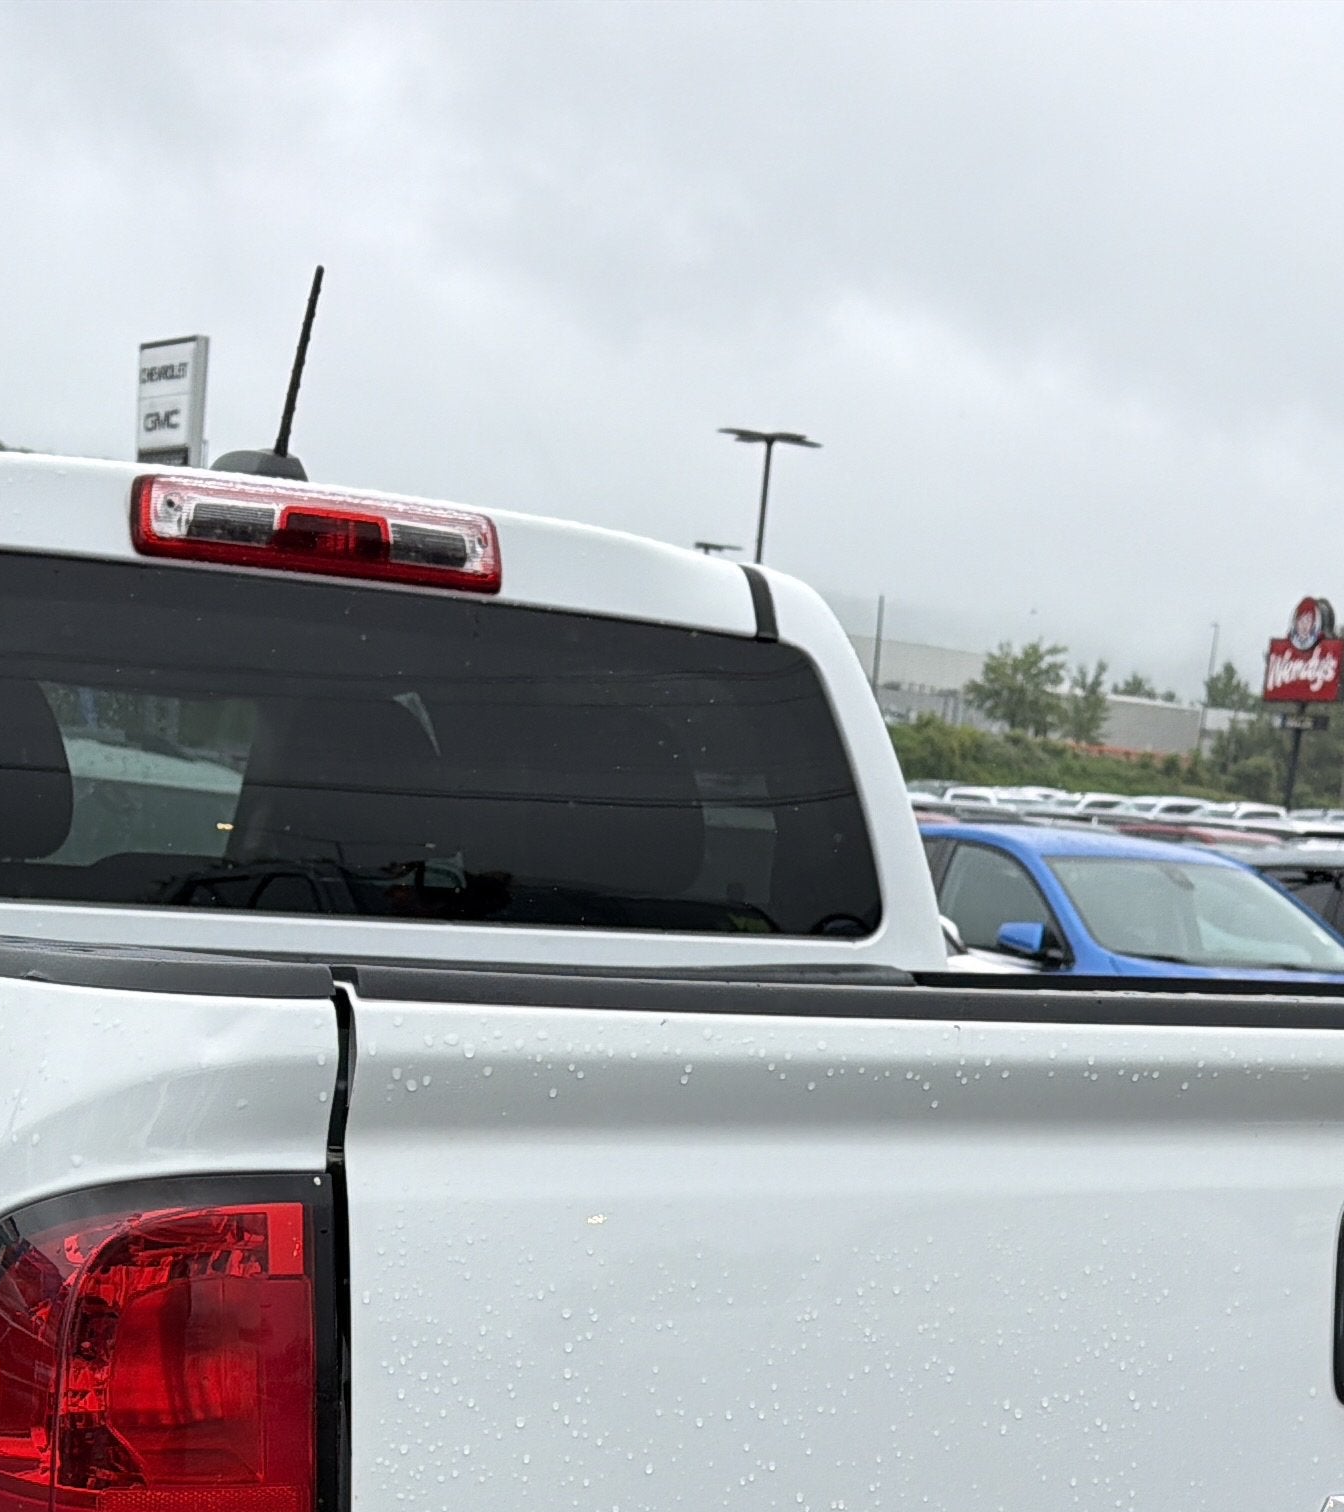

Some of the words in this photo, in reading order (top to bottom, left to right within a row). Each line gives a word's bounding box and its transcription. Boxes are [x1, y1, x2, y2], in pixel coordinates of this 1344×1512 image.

[140, 362, 188, 384] CHEVROLET
[143, 408, 180, 432] GMC
[1267, 645, 1339, 693] Wendy's
